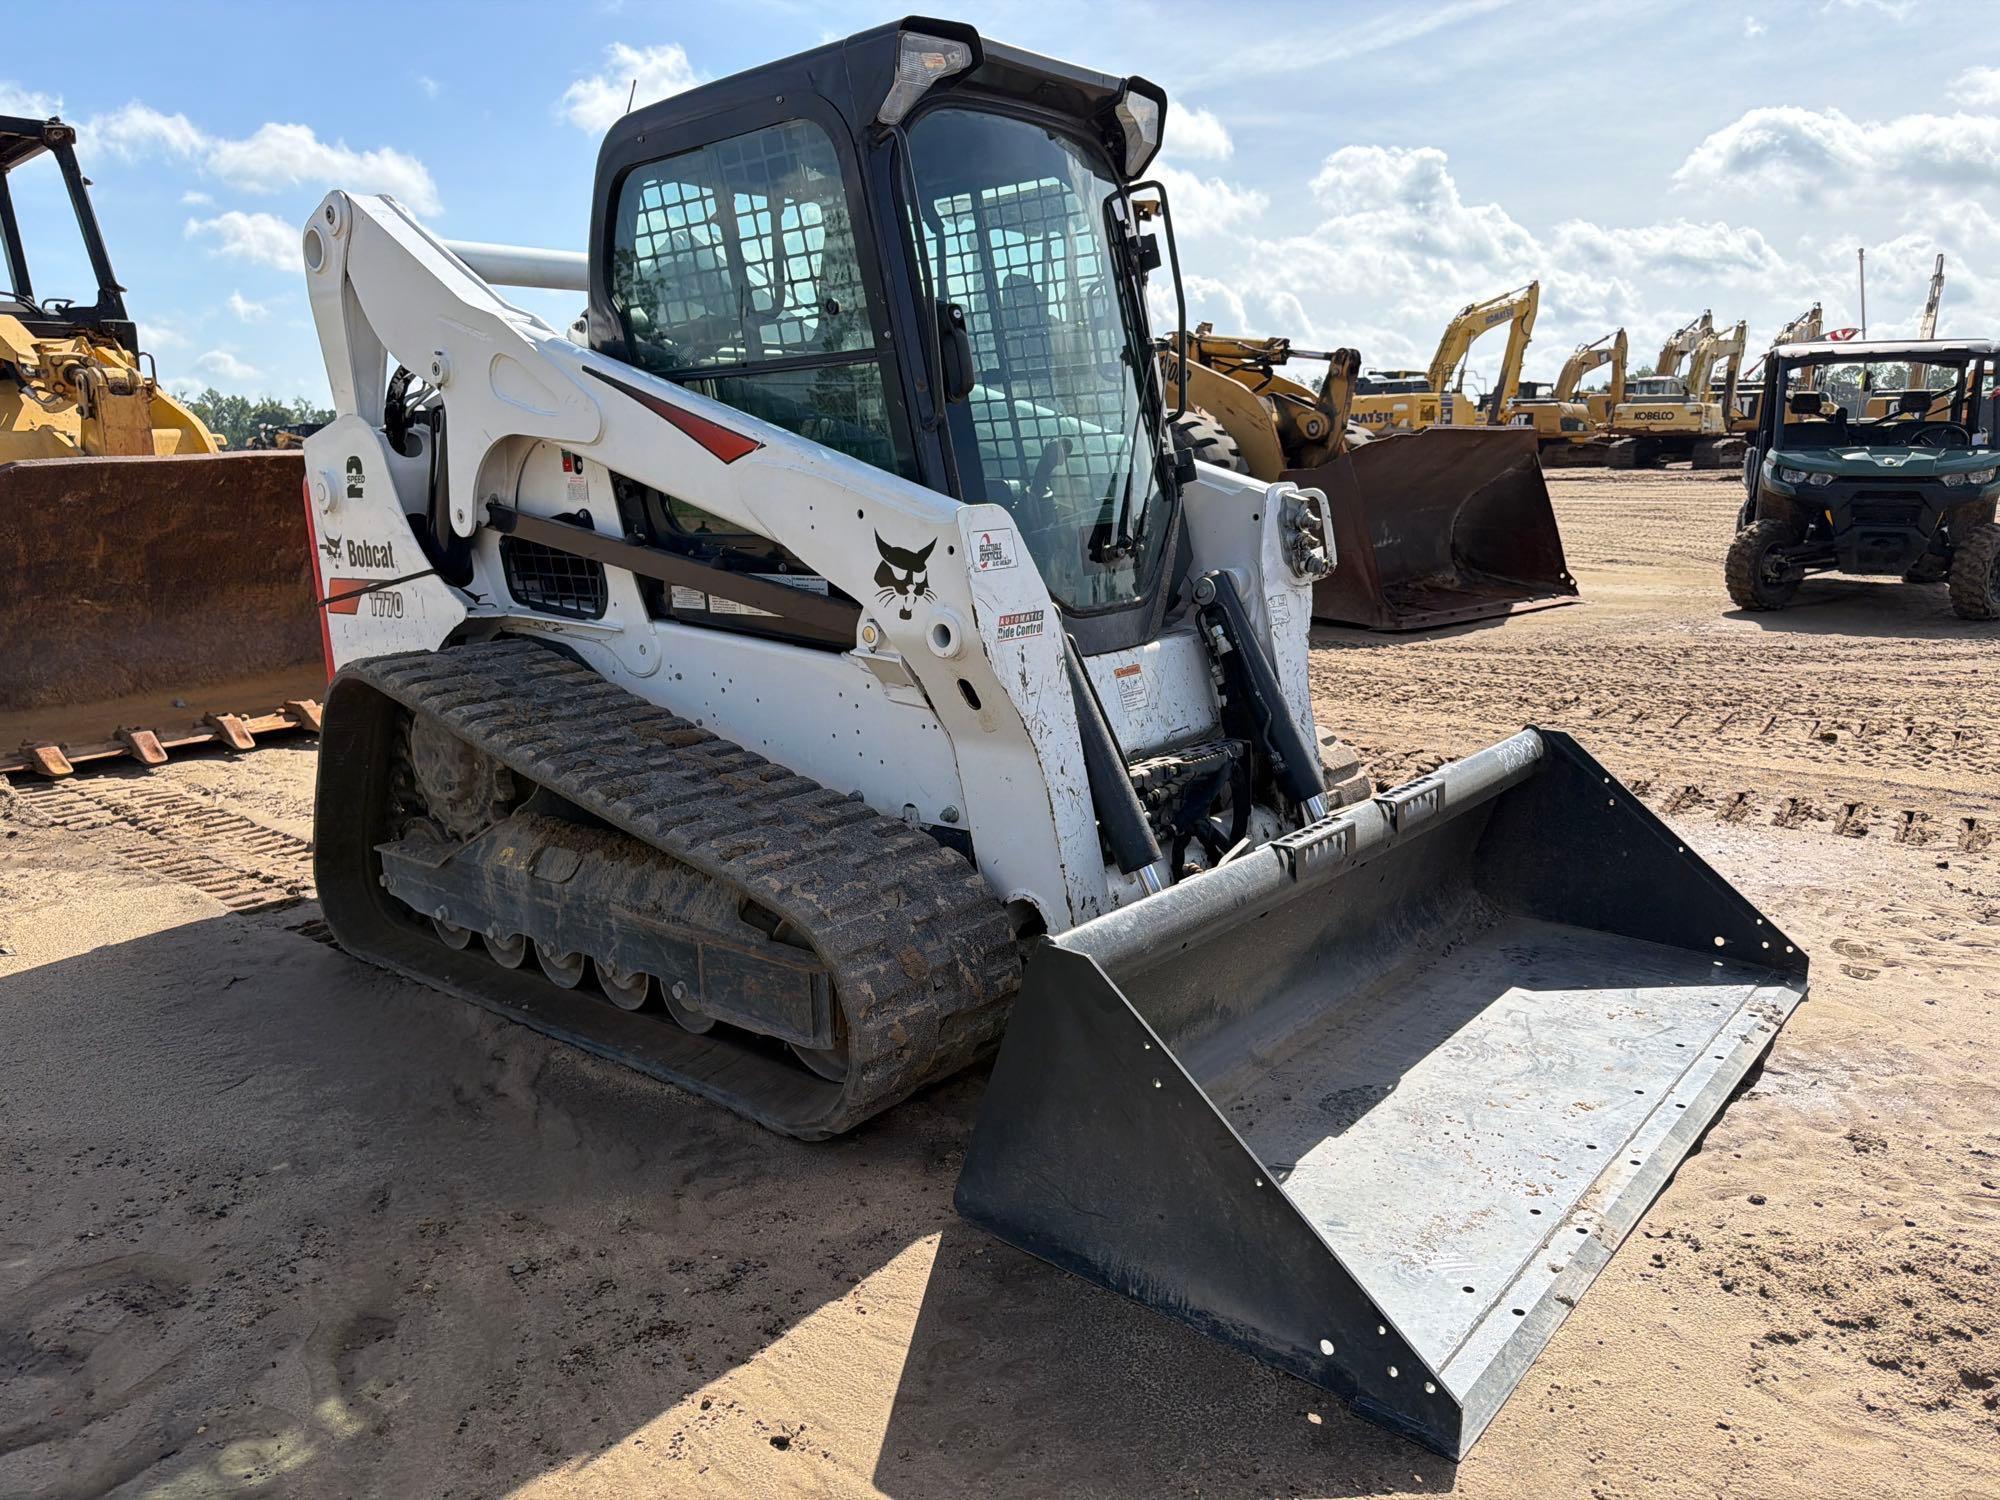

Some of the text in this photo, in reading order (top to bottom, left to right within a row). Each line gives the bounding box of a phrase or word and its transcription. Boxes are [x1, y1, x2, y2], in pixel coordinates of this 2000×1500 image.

[1510, 413, 1528, 426] AT
[1633, 410, 1675, 421] KOBELCO
[346, 474, 366, 484] SPEED
[346, 539, 396, 568] Bobcat
[368, 591, 405, 618] T770
[999, 611, 1044, 626] AUTOMATIC
[1015, 622, 1044, 638] Control
